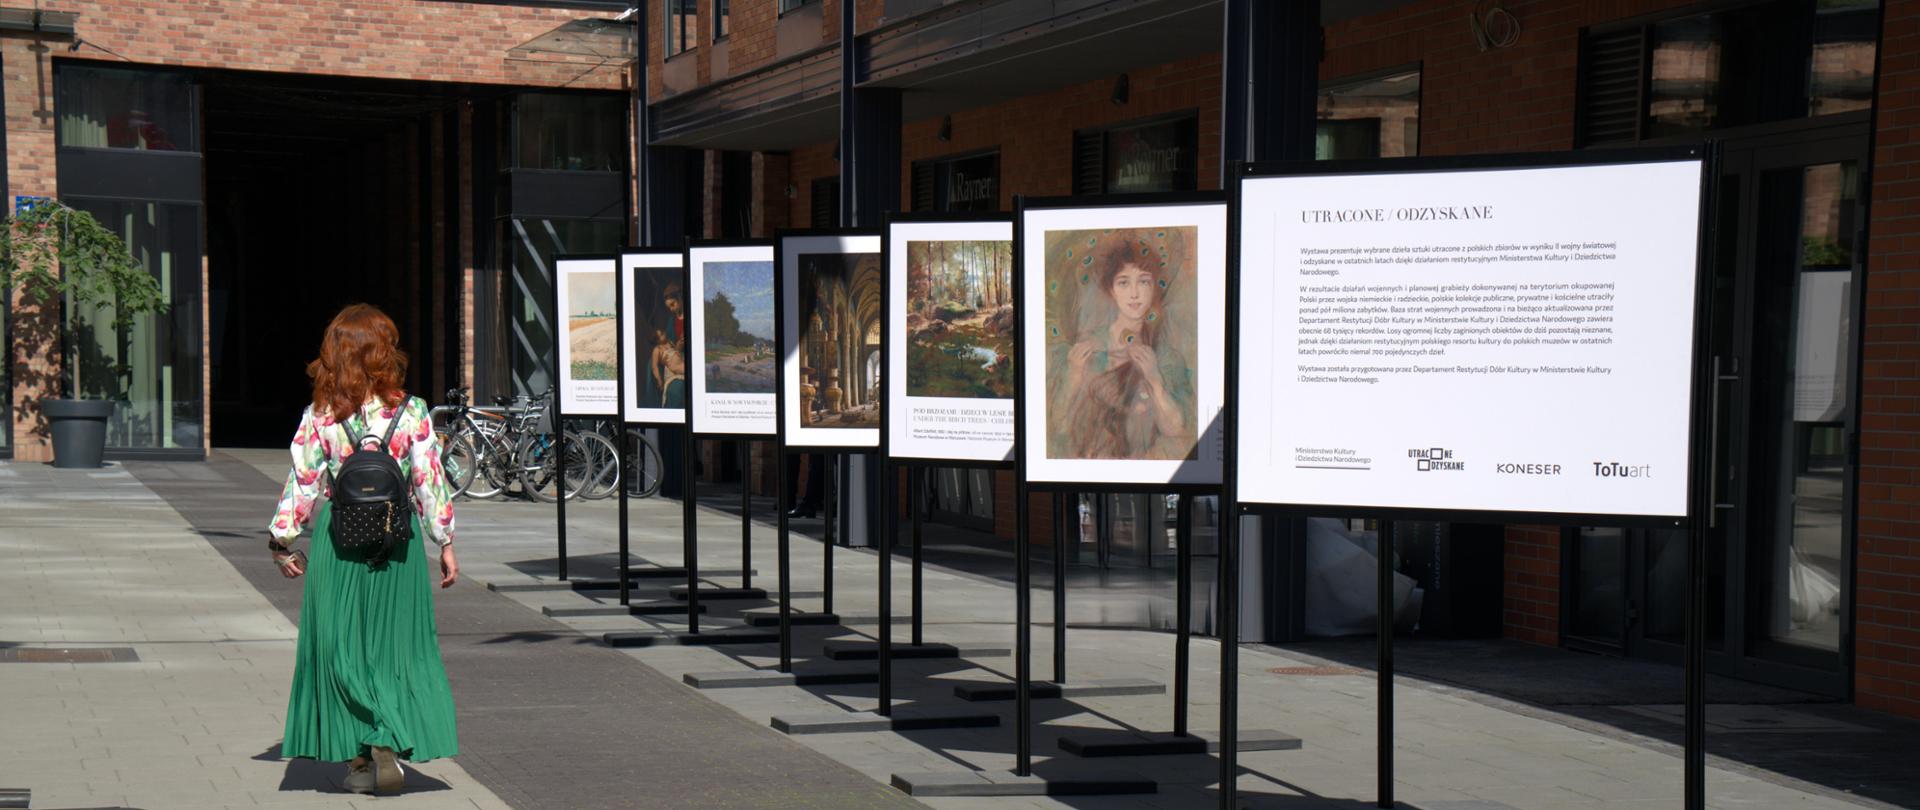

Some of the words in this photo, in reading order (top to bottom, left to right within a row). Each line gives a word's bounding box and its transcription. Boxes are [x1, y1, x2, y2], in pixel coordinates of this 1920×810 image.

[957, 172, 992, 209] Rayner
[1302, 209, 1384, 223] UTRACONE
[1397, 206, 1493, 221] ODZYSKANE
[1363, 247, 1391, 255] wybrane
[1467, 244, 1494, 252] polskich
[1529, 243, 1554, 251] wyniku
[1560, 242, 1581, 251] wojny
[1582, 242, 1617, 250] światowej
[1451, 255, 1498, 264] restytucyjnym
[1544, 254, 1569, 262] Kultury
[1367, 285, 1403, 293] wojennych
[1409, 284, 1439, 293] planowej
[1471, 284, 1518, 292] dokonywanej
[1571, 282, 1615, 290] okupowanej
[1587, 293, 1615, 302] utraciły
[1542, 316, 1586, 324] Narodowego
[1453, 327, 1490, 336] zaginionych
[1421, 338, 1451, 346] polskiego
[1513, 337, 1540, 346] polskich
[1298, 365, 1326, 374] Wystawa
[1413, 365, 1455, 374] Departament
[1456, 366, 1488, 374] Restytucji
[1586, 366, 1612, 374] Kultury
[1497, 464, 1561, 474] KONESER
[1593, 462, 1650, 477] ToTuart
